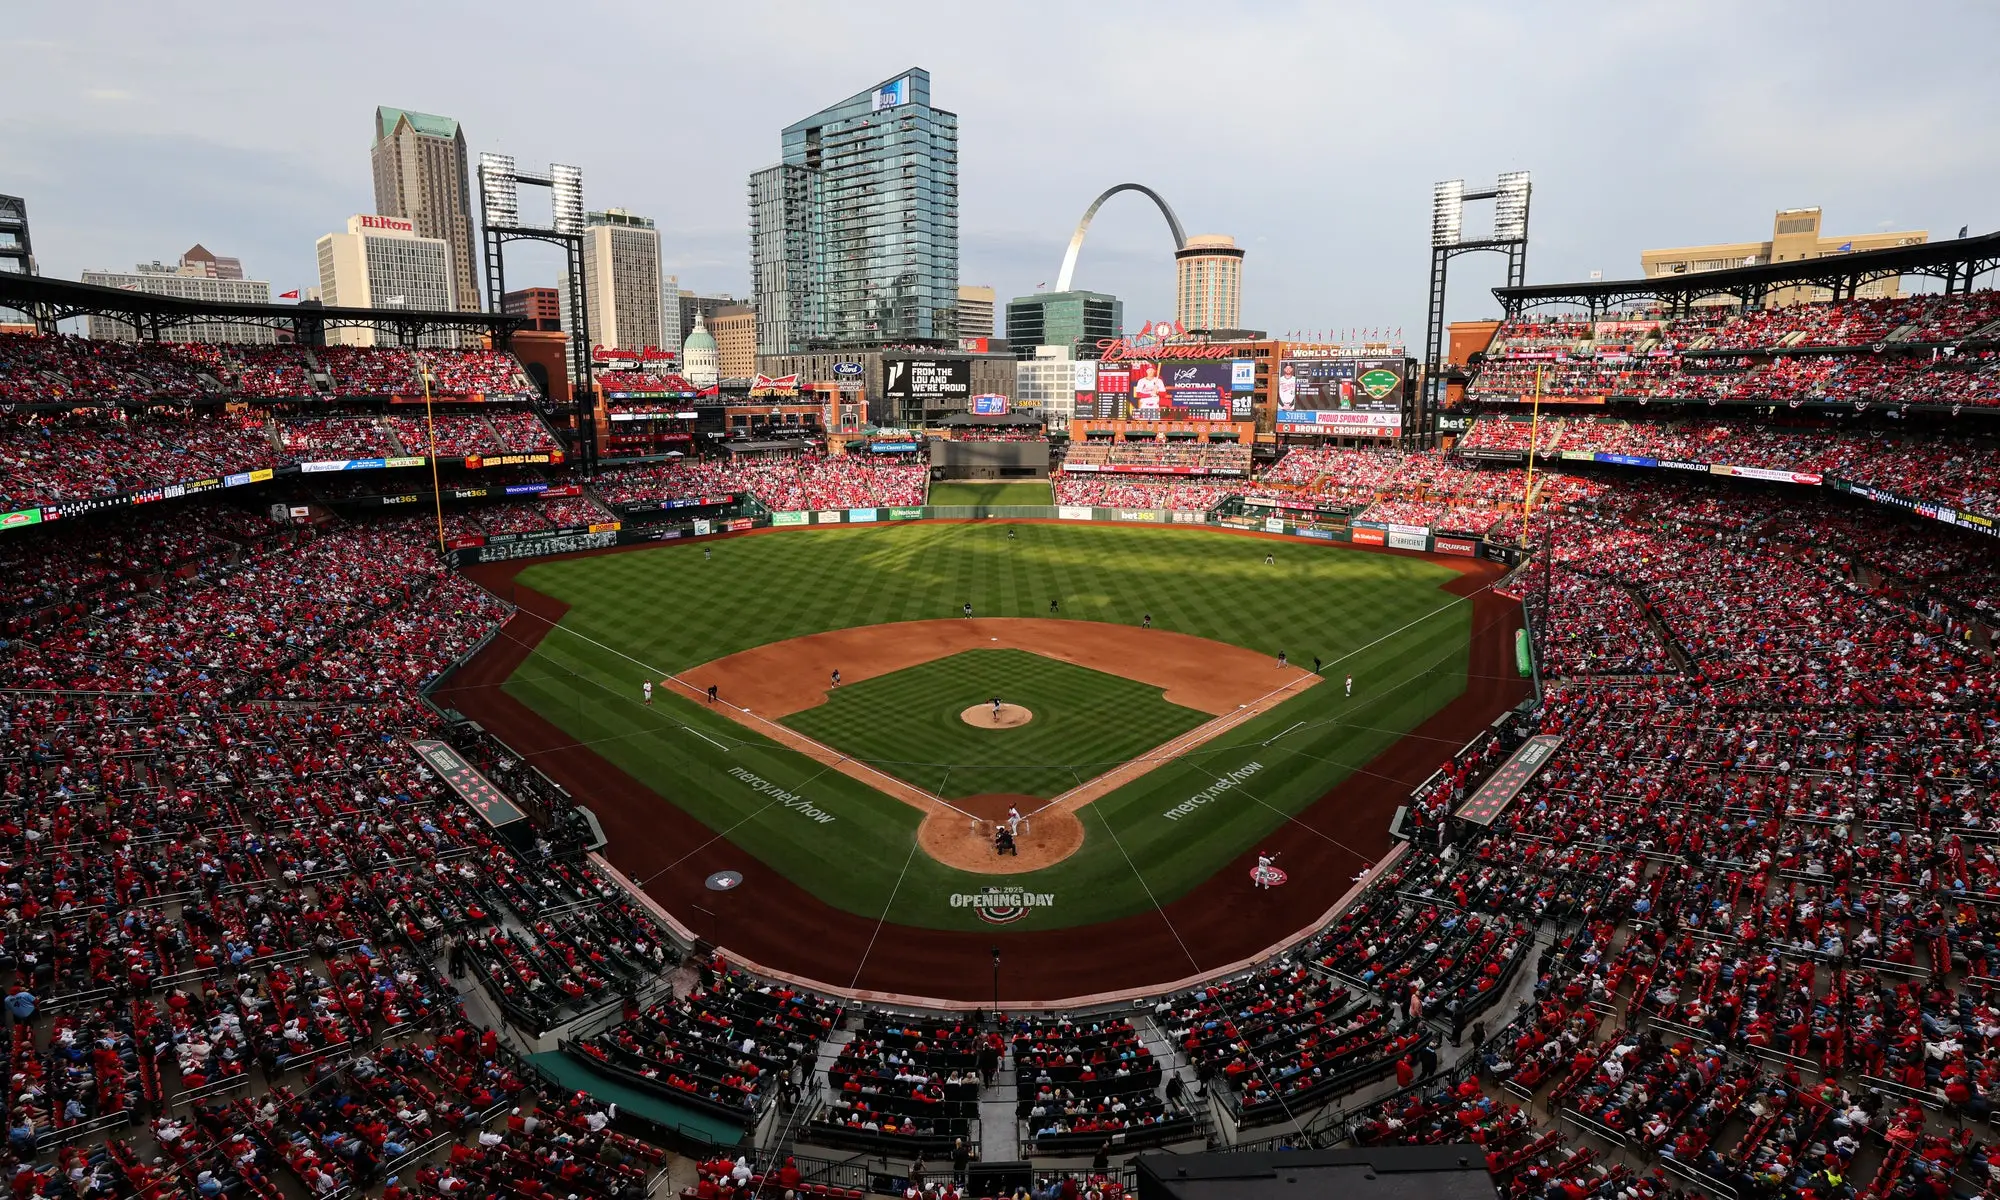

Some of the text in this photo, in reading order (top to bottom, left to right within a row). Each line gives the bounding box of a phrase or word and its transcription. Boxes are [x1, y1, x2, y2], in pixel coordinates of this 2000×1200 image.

[361, 215, 412, 231] Hilton
[1096, 337, 1233, 361] Budweiser
[1293, 349, 1328, 357] WORLD
[840, 363, 857, 373] Ford
[912, 368, 952, 376] FROM THE
[754, 378, 798, 388] Budweiser
[774, 389, 798, 397] HOUSE
[1232, 396, 1252, 408] stl
[1286, 412, 1308, 420] STIFEL
[1318, 414, 1368, 423] PROUD SPONSOR
[1295, 424, 1324, 433] BROWN
[1333, 425, 1379, 435] CROUPPEN
[502, 456, 524, 465] MAC
[525, 455, 549, 463] LAND
[1658, 461, 1709, 471] LINDENWOOD.EDU
[456, 489, 487, 498] bet365
[383, 495, 418, 504] bet365
[1122, 511, 1154, 519] bet365
[1391, 536, 1424, 547] PERFICIENT
[1437, 542, 1472, 551] EQUIFAX
[727, 766, 836, 824] mercy.net/now
[1163, 761, 1264, 820] mercy.net/now
[950, 892, 1055, 907] OPENING DAY
